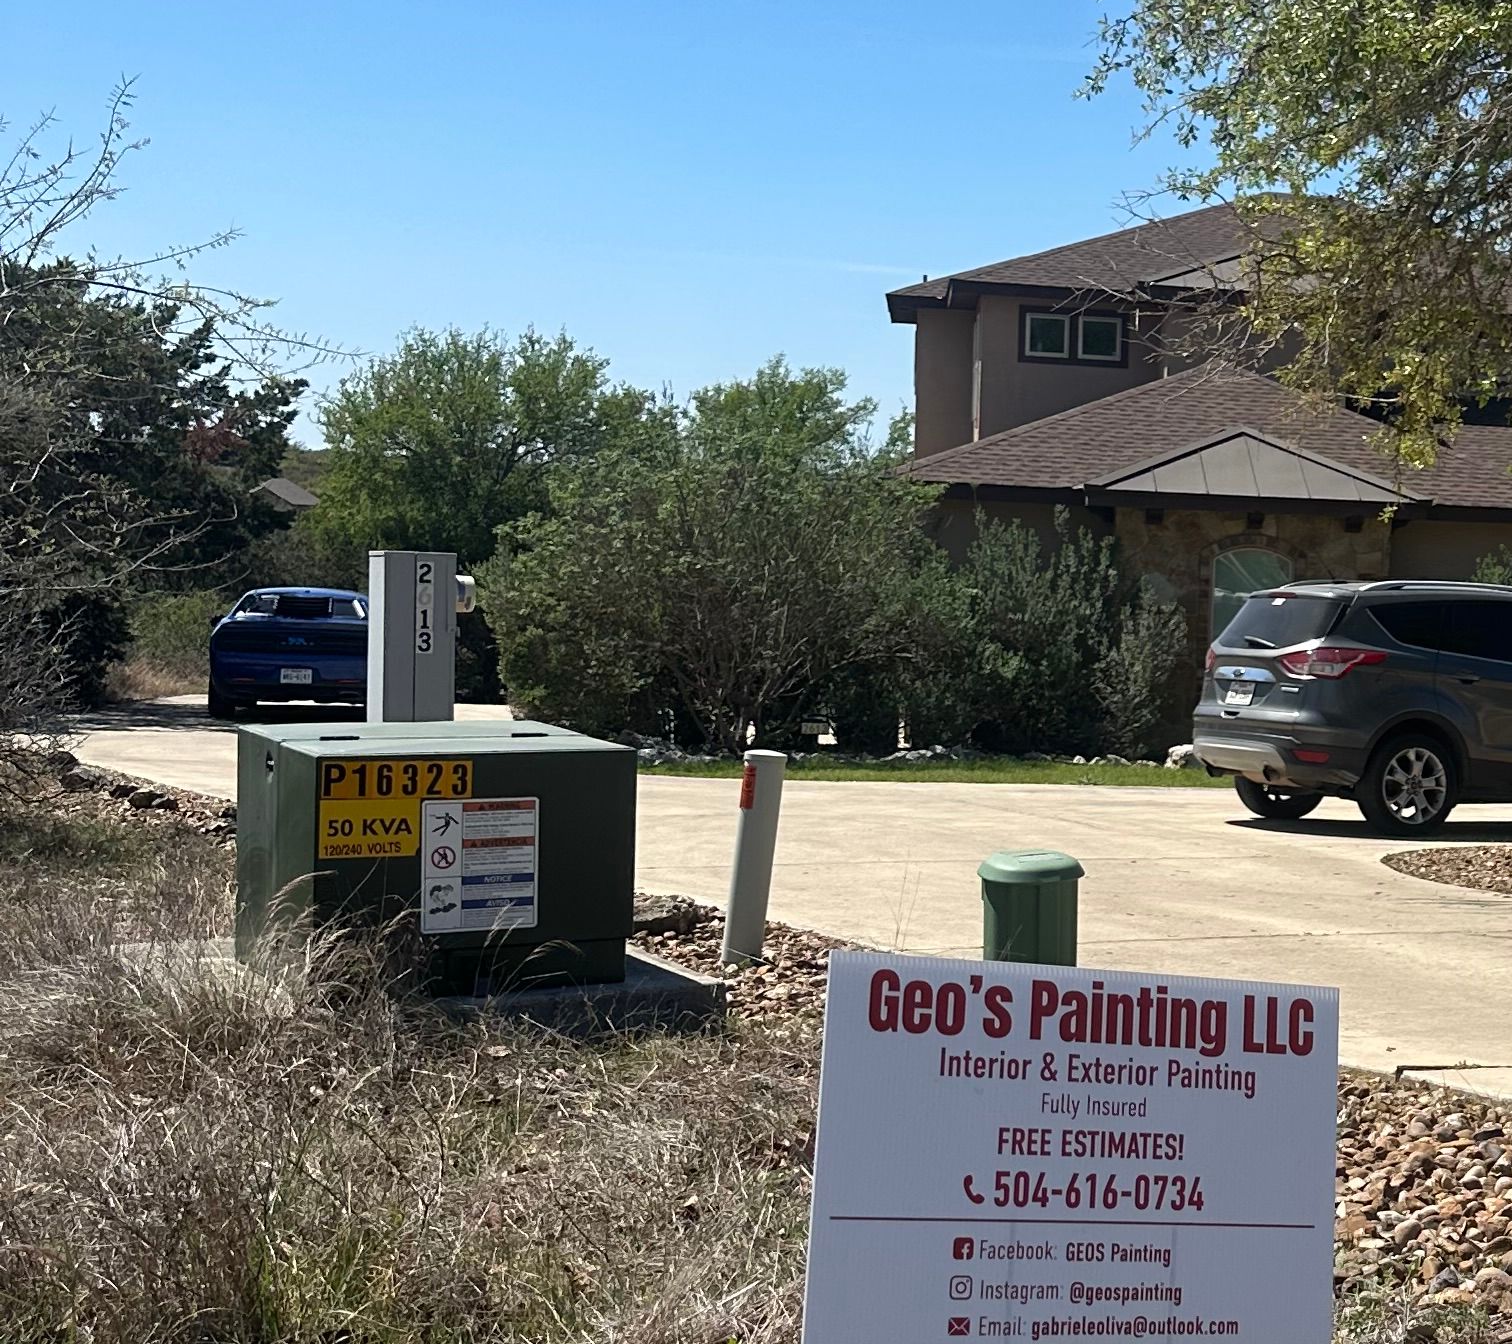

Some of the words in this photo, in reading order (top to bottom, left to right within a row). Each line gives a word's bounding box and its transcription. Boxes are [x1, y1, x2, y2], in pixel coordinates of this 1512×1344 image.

[418, 563, 432, 652] 2613
[323, 764, 468, 796] P16323
[327, 819, 354, 837] 50
[362, 818, 412, 836] KVA
[324, 844, 362, 856] 120/240
[367, 842, 401, 853] VOLTS
[869, 969, 1013, 1038] Geo’s
[1029, 980, 1227, 1056] Painting
[1243, 995, 1314, 1056] LLC
[940, 1047, 1032, 1080] Interior
[1040, 1052, 1058, 1081] &
[1068, 1054, 1158, 1086] Exterior
[1168, 1059, 1255, 1099] Painting
[1042, 1093, 1080, 1120] Fully
[1087, 1095, 1146, 1117] Insured
[998, 1127, 1052, 1156] FREE
[1061, 1130, 1184, 1160] ESTIMATES!
[994, 1171, 1204, 1211] 504-616-0734
[980, 1240, 1056, 1260] Facebook:
[1066, 1242, 1104, 1262] GEOS
[1111, 1243, 1170, 1268] Painting
[980, 1280, 1063, 1305] Instagram:
[1070, 1282, 1181, 1306] @geospainting
[979, 1316, 1026, 1336] Email:
[1032, 1316, 1238, 1340] gabrieleoliva@outlook.com
